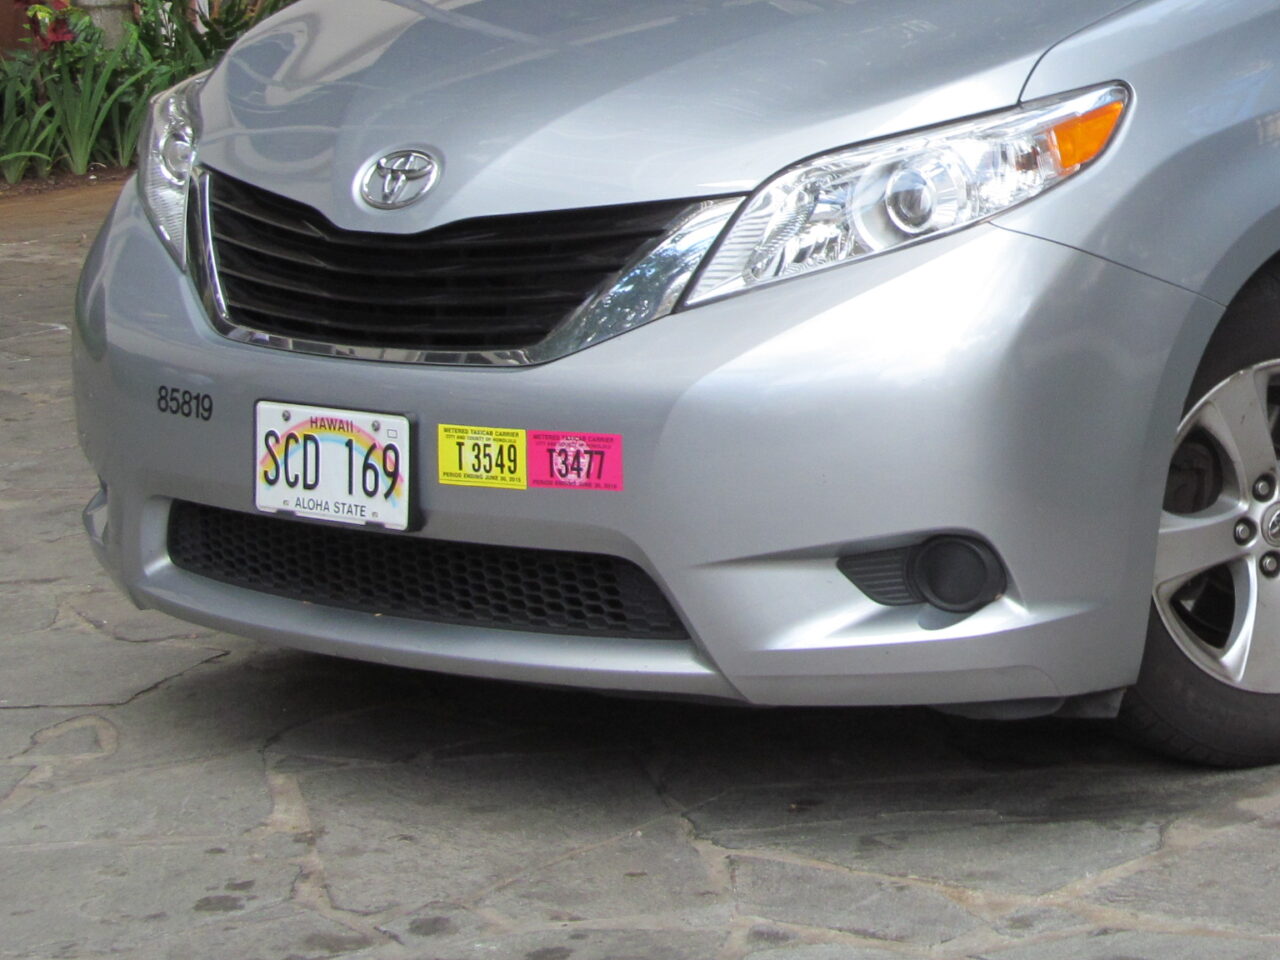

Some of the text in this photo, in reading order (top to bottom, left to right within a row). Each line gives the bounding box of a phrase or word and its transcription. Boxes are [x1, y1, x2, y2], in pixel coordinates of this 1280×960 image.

[157, 386, 213, 421] 85819
[310, 416, 353, 433] HAWAII
[263, 429, 400, 500] SCD 169
[456, 441, 517, 474] T 3549
[295, 497, 367, 517] ALOHA STATE
